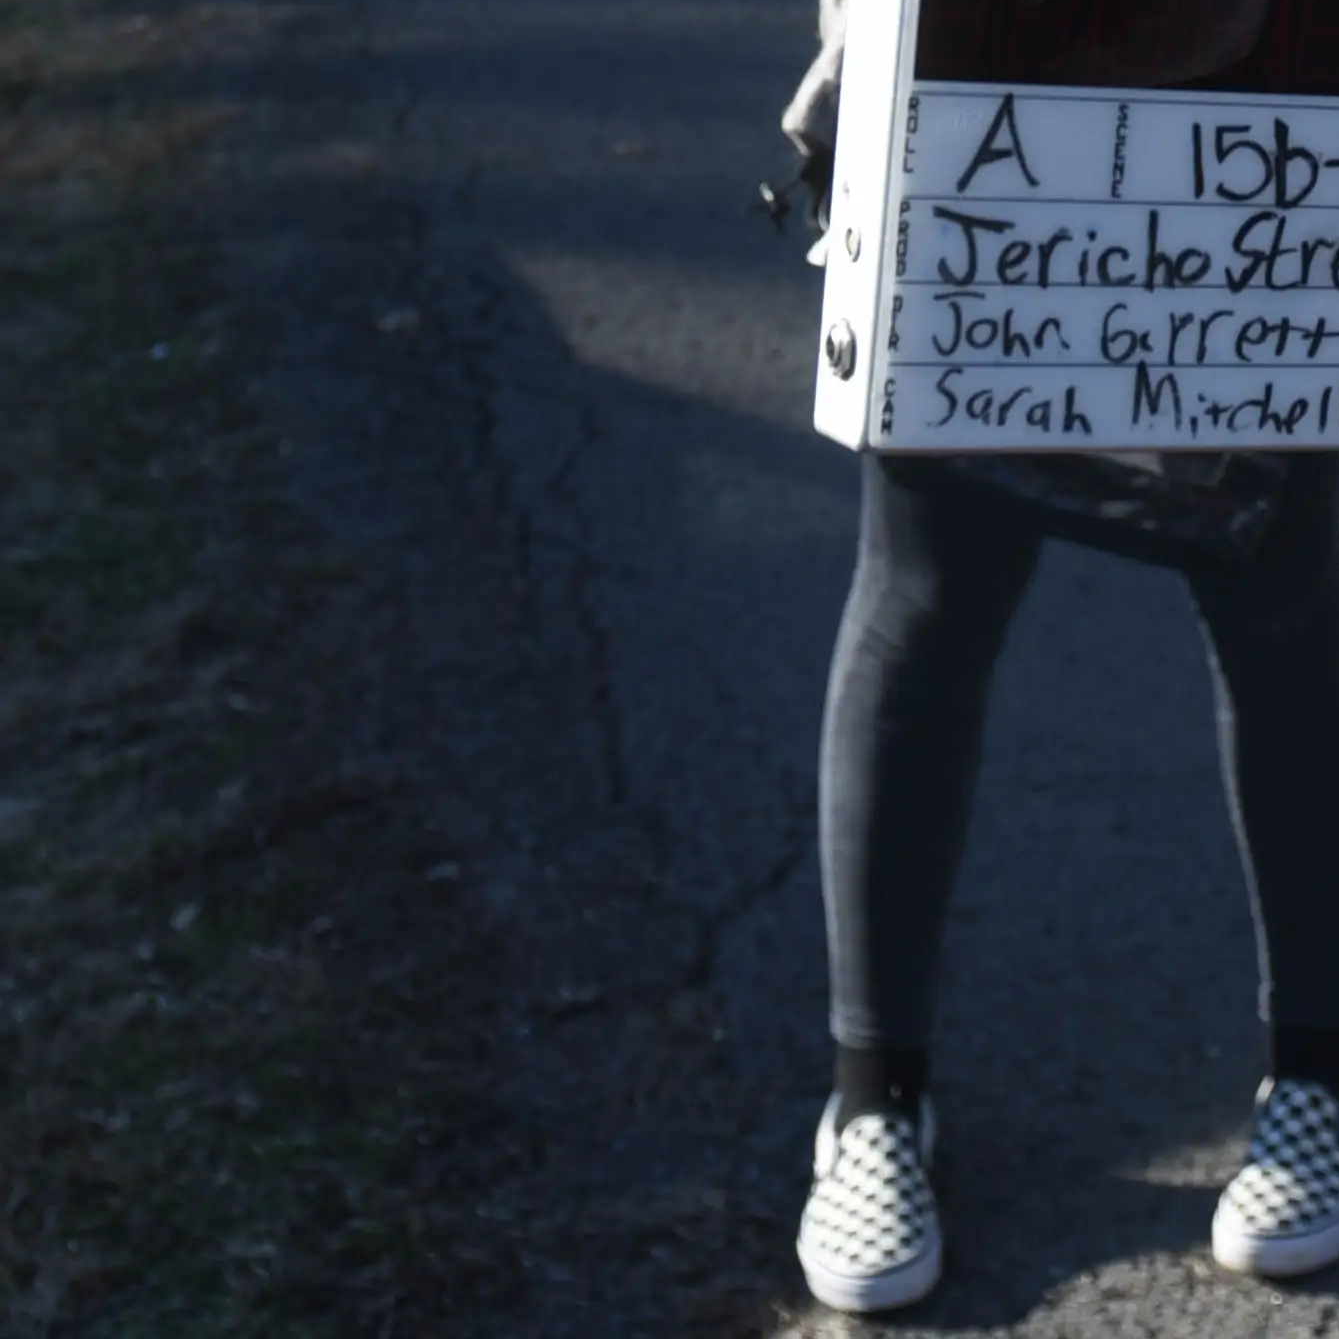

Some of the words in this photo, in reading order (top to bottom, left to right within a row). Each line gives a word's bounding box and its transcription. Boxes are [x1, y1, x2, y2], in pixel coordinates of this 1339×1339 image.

[903, 96, 920, 173] ROLL
[957, 92, 1040, 193] A
[1111, 103, 1129, 199] SCENE
[896, 201, 911, 276] PROD
[932, 205, 1211, 293] Jericho
[888, 296, 903, 351] DIR
[932, 291, 1071, 357] John
[881, 379, 895, 435] CAM
[926, 368, 1092, 435] Sarah
